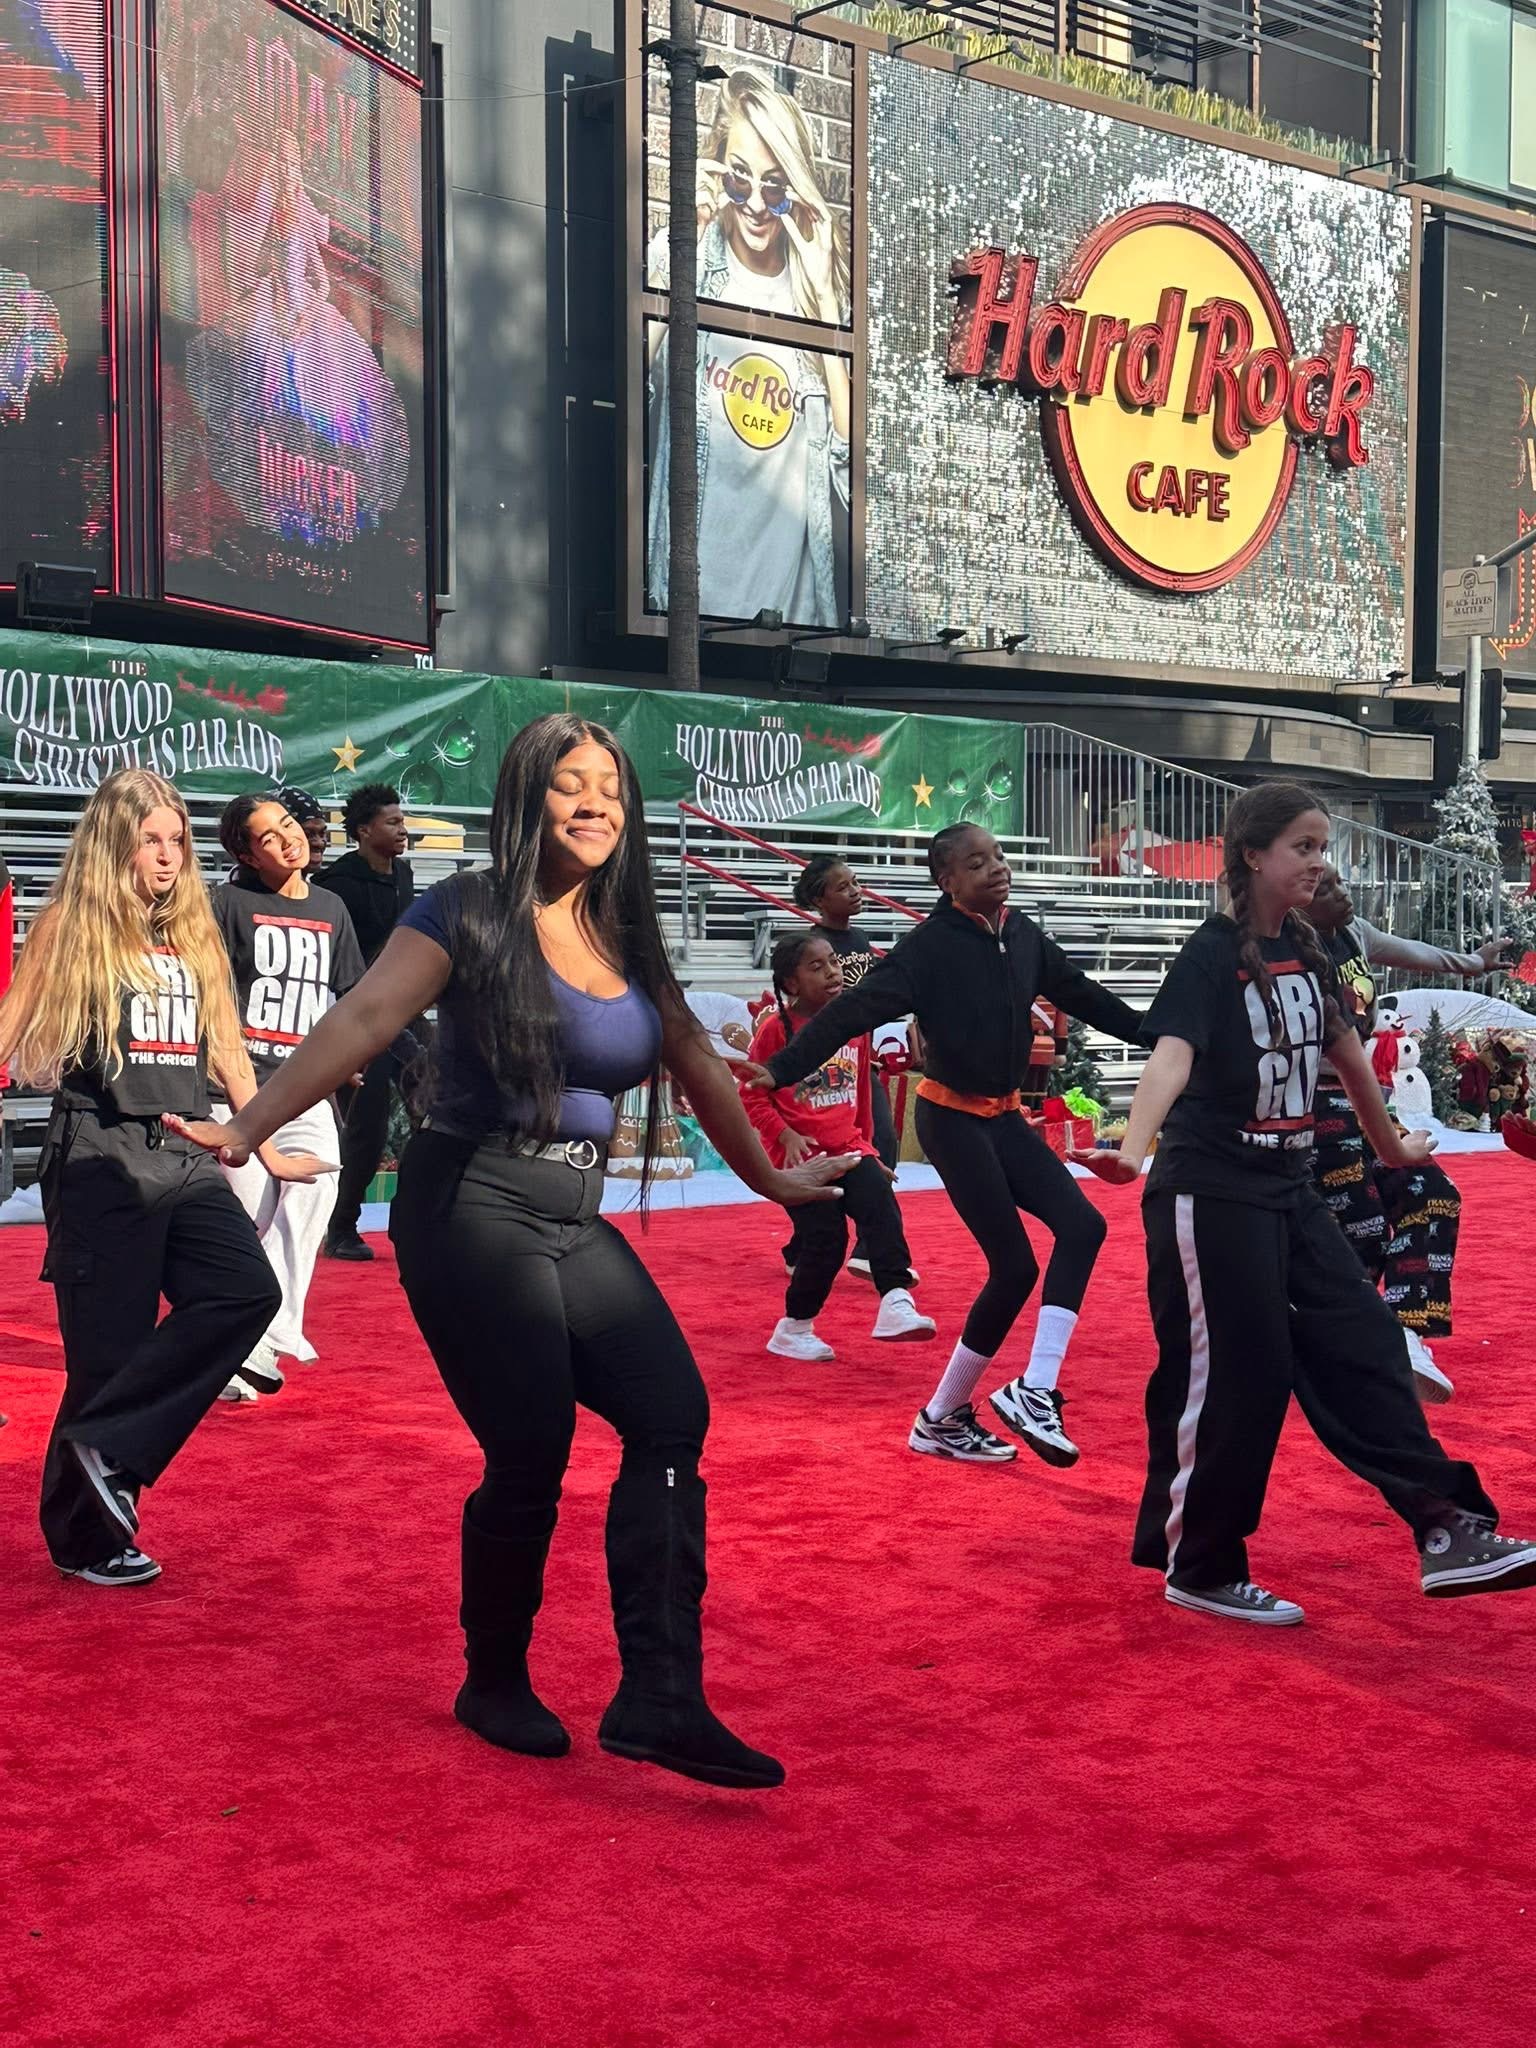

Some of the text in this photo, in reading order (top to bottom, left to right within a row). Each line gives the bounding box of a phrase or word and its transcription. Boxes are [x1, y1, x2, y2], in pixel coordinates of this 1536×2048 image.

[950, 247, 1187, 408] Hard
[1189, 296, 1375, 468] Rock
[762, 374, 803, 416] Roc
[742, 414, 774, 434] CAFE
[1127, 461, 1230, 522] CAFE
[109, 659, 147, 676] THE
[759, 716, 785, 729] THE
[181, 717, 287, 786] PARADE
[675, 723, 802, 784] HOLLYWOOD
[696, 760, 882, 823] CHRISTMAS PARADE
[254, 924, 331, 988] ORI
[130, 992, 197, 1044] GIN
[246, 976, 328, 1037] GIN
[1244, 970, 1325, 1050] ORI
[128, 1052, 155, 1065] THE
[809, 1090, 859, 1110] TAKEOVE
[1237, 1129, 1280, 1149] THE
